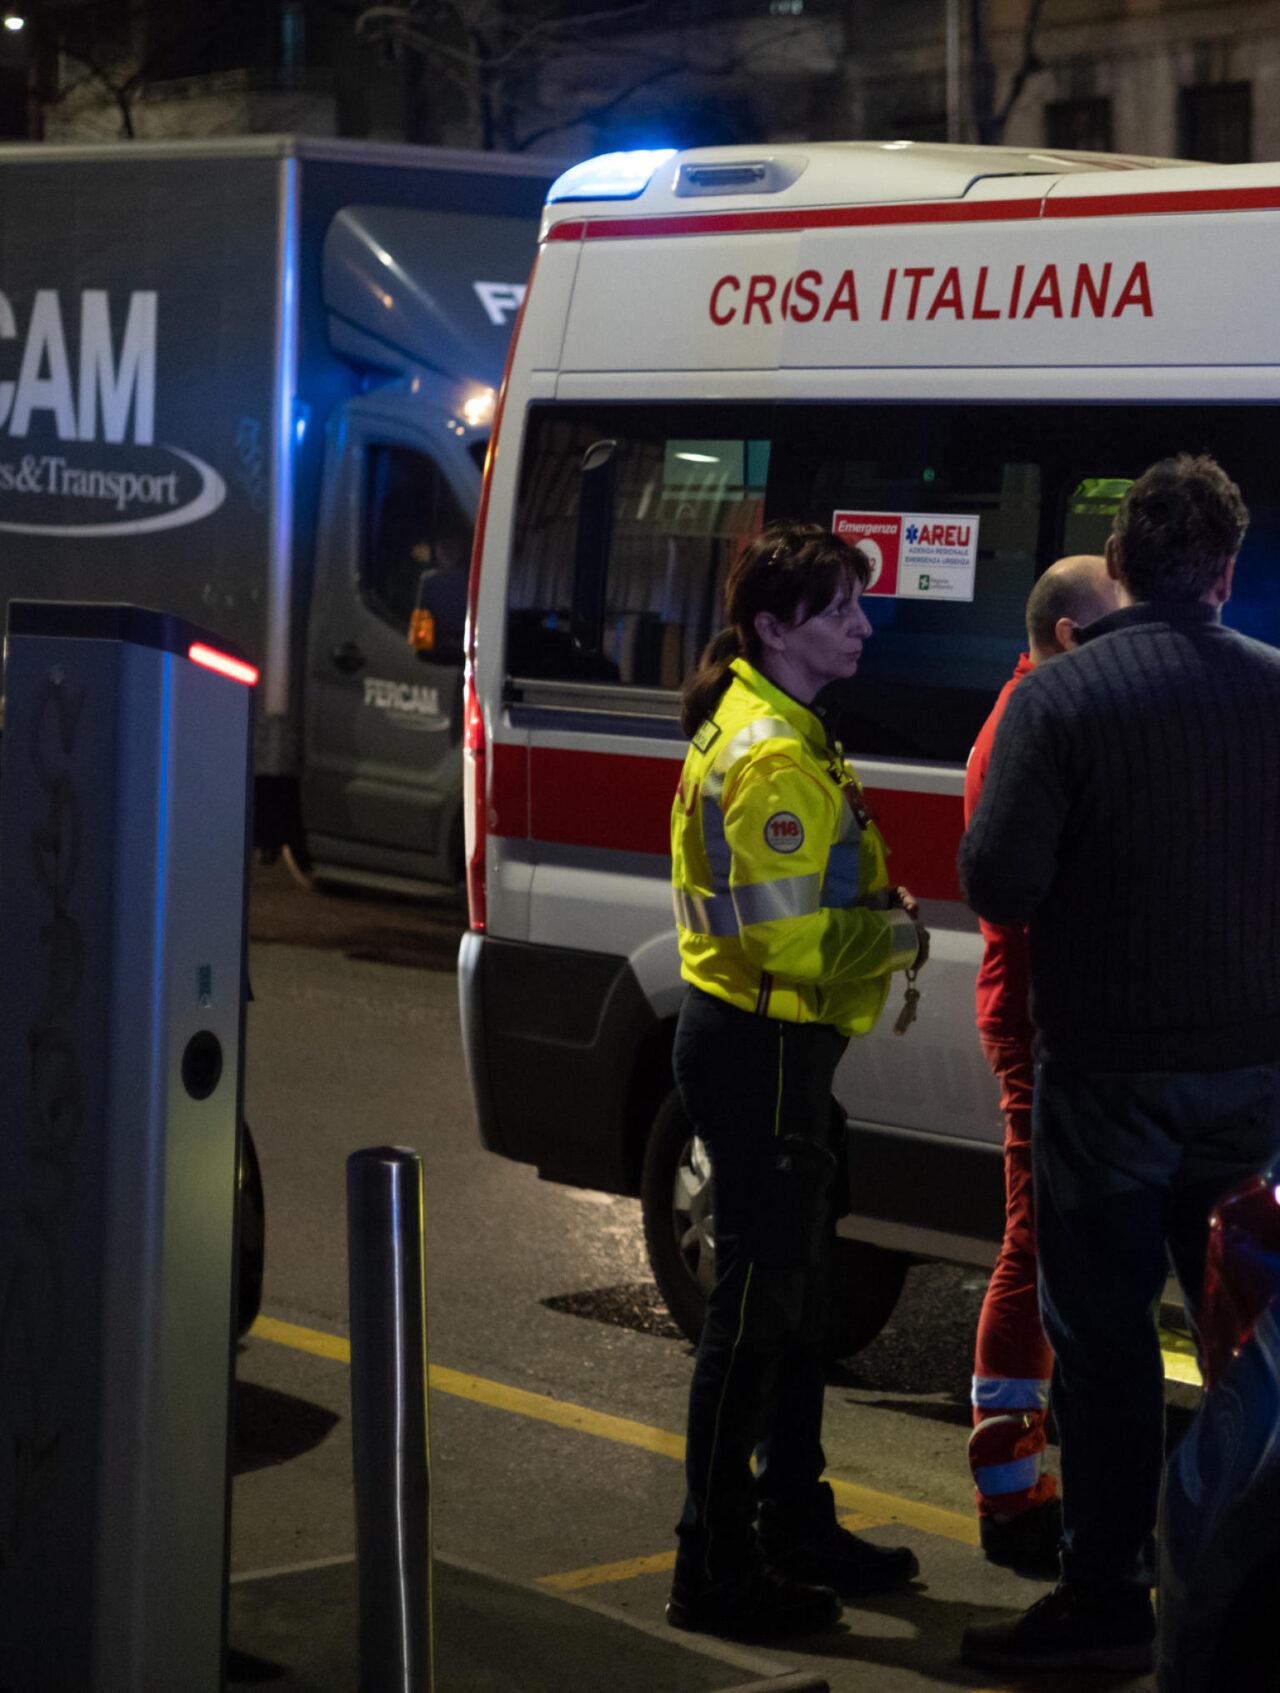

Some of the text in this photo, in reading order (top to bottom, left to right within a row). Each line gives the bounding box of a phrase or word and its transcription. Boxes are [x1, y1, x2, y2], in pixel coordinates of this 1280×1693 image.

[881, 261, 1154, 321] ITALIANA
[838, 520, 898, 536] Emergenza
[918, 524, 971, 547] AREU
[771, 821, 799, 836] 118
